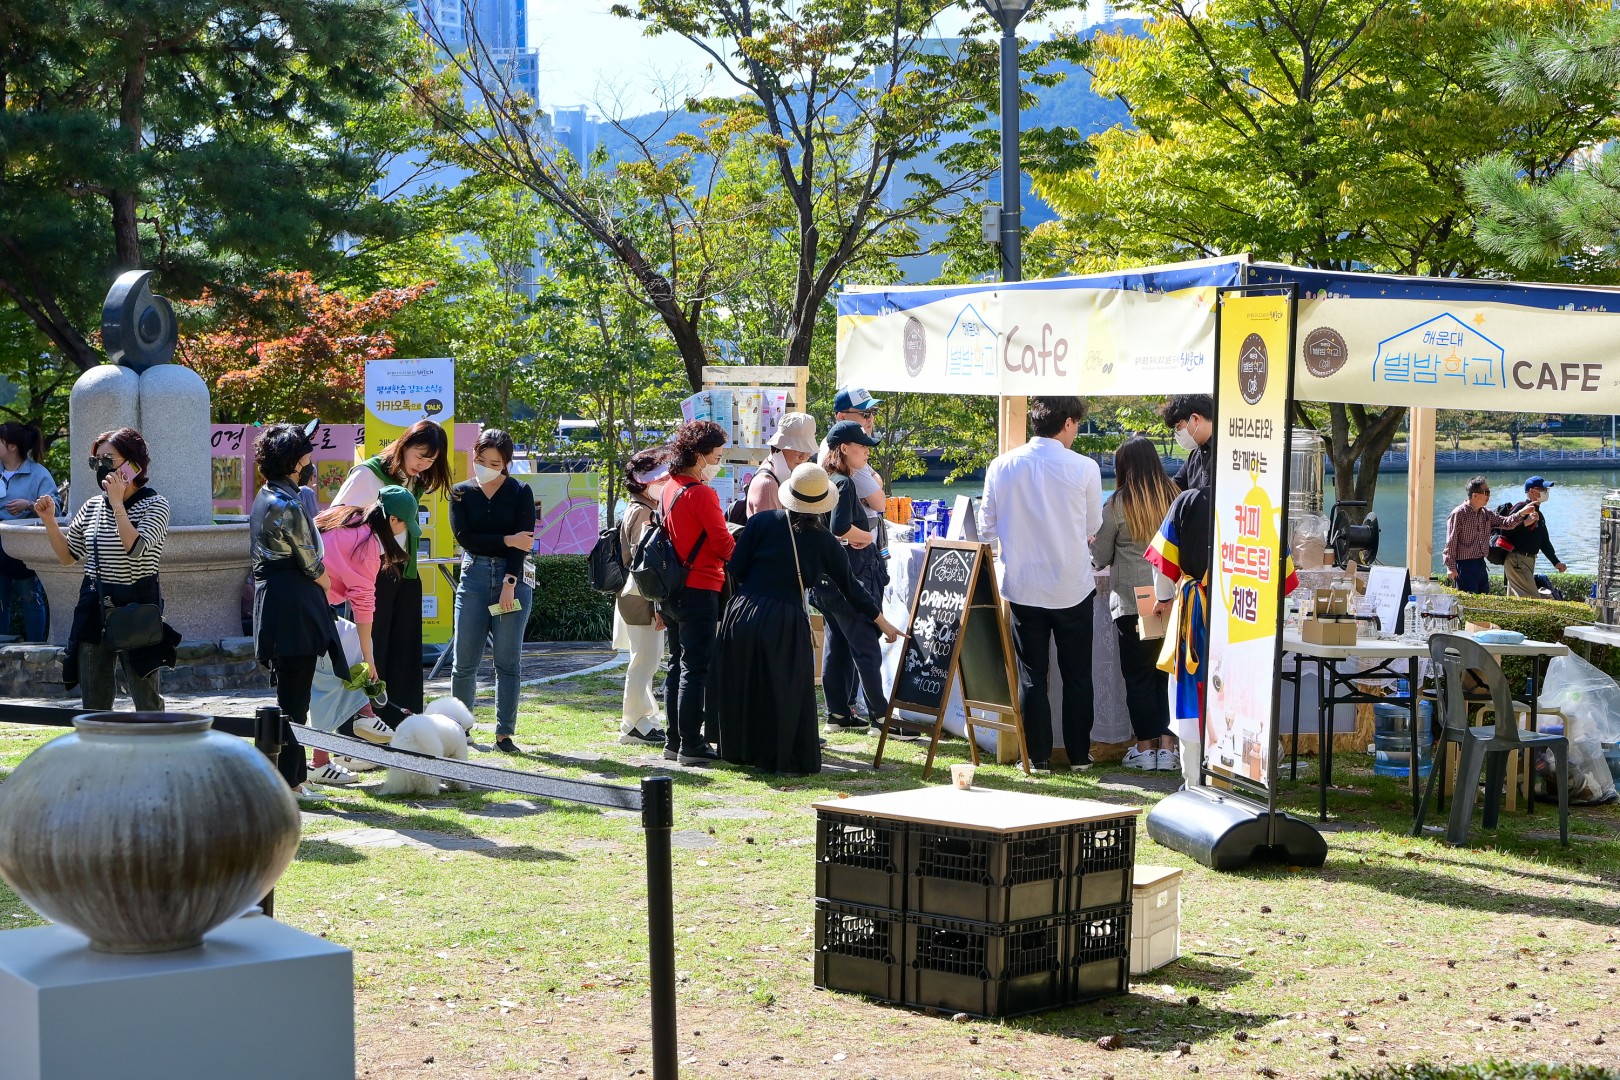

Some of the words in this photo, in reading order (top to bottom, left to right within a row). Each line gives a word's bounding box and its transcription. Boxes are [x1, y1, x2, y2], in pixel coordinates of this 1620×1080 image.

[1004, 323, 1068, 377] Cafe
[1422, 330, 1464, 348] 해운대
[1384, 351, 1497, 387] 별밤학교
[1513, 360, 1603, 392] CAFE
[376, 384, 407, 395] 평생학습
[408, 384, 423, 394] 강좌
[1229, 417, 1273, 441] 바리스타와
[1232, 449, 1267, 474] 함께하는
[1234, 505, 1261, 538] 커피
[1221, 542, 1271, 581] 핸드드립
[1231, 586, 1258, 622] 체험
